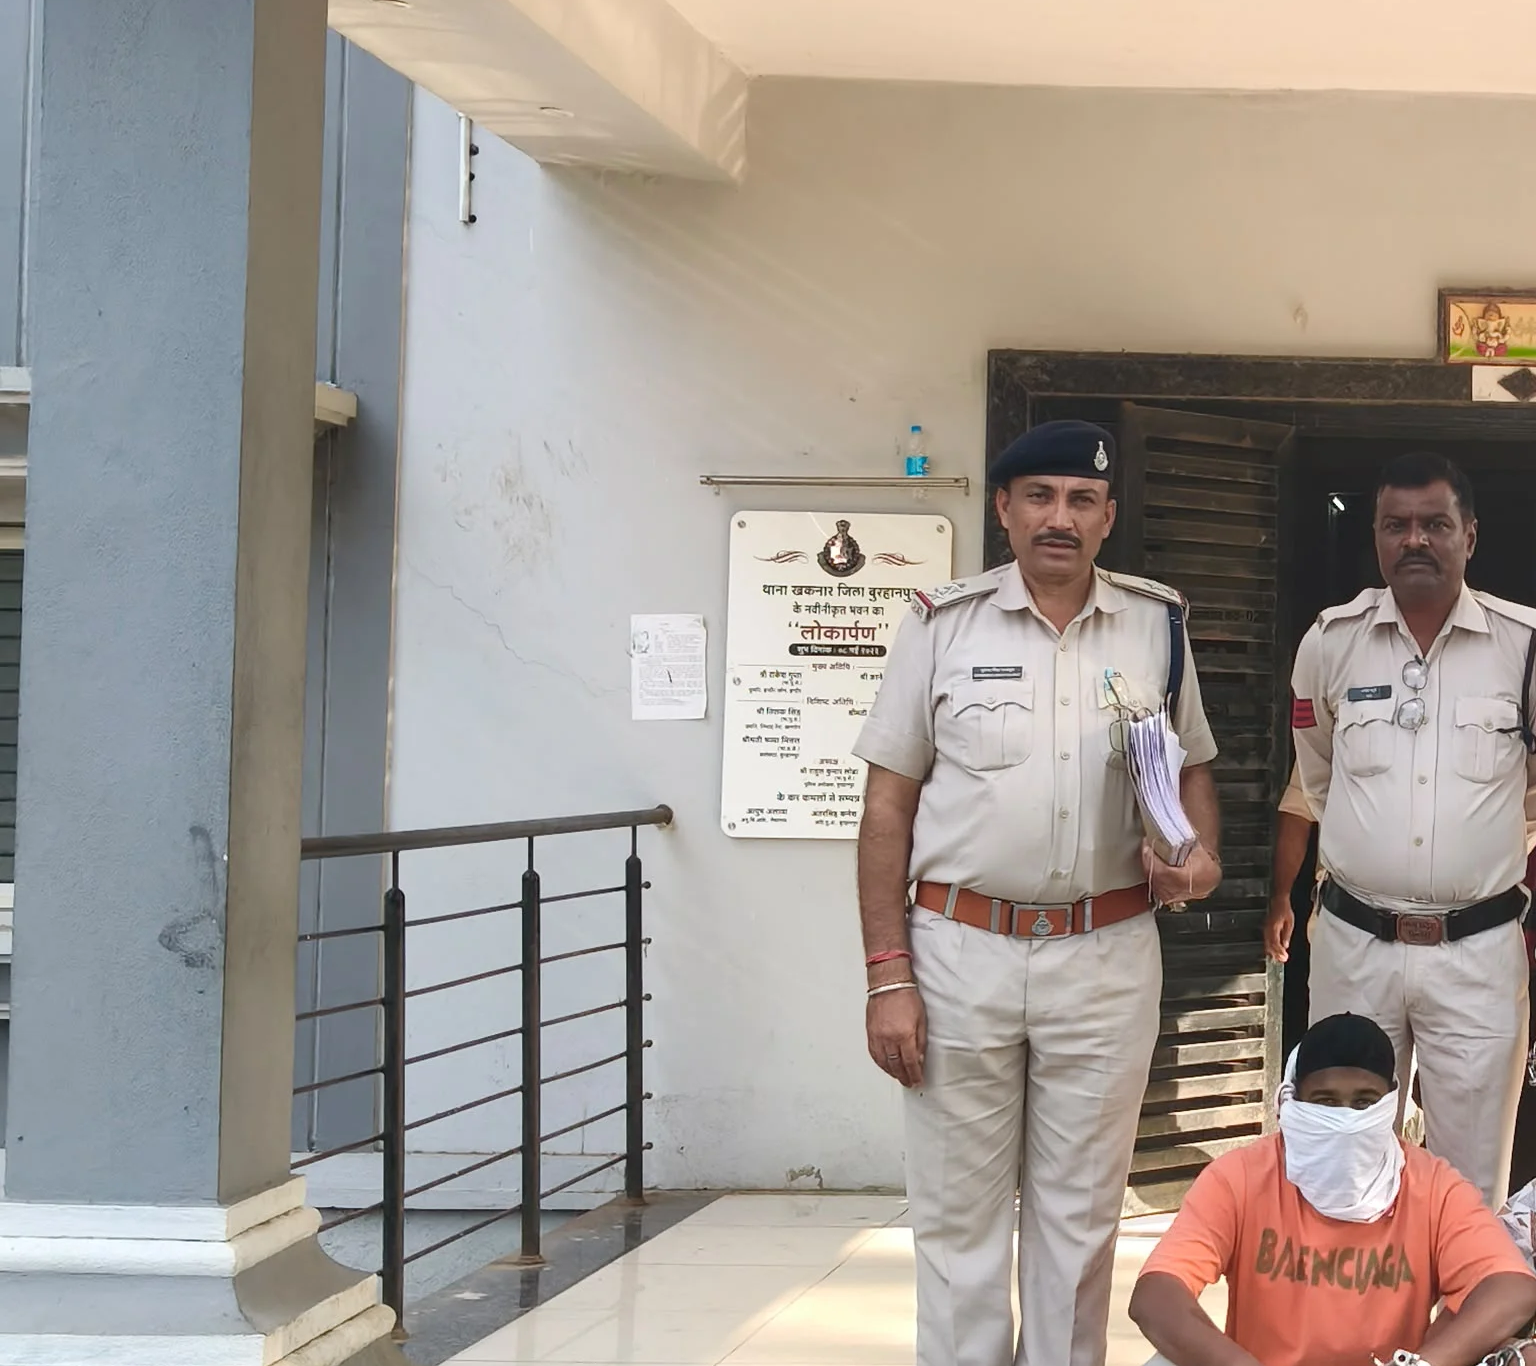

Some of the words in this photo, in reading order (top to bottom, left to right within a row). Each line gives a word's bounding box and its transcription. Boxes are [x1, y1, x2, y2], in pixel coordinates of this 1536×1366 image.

[763, 585, 787, 596] थाना
[791, 585, 833, 597] खकनार
[837, 582, 865, 597] जिला
[792, 601, 802, 613] के
[805, 601, 846, 618] नवीनीकृत
[849, 605, 869, 616] भवन
[872, 606, 884, 616] का
